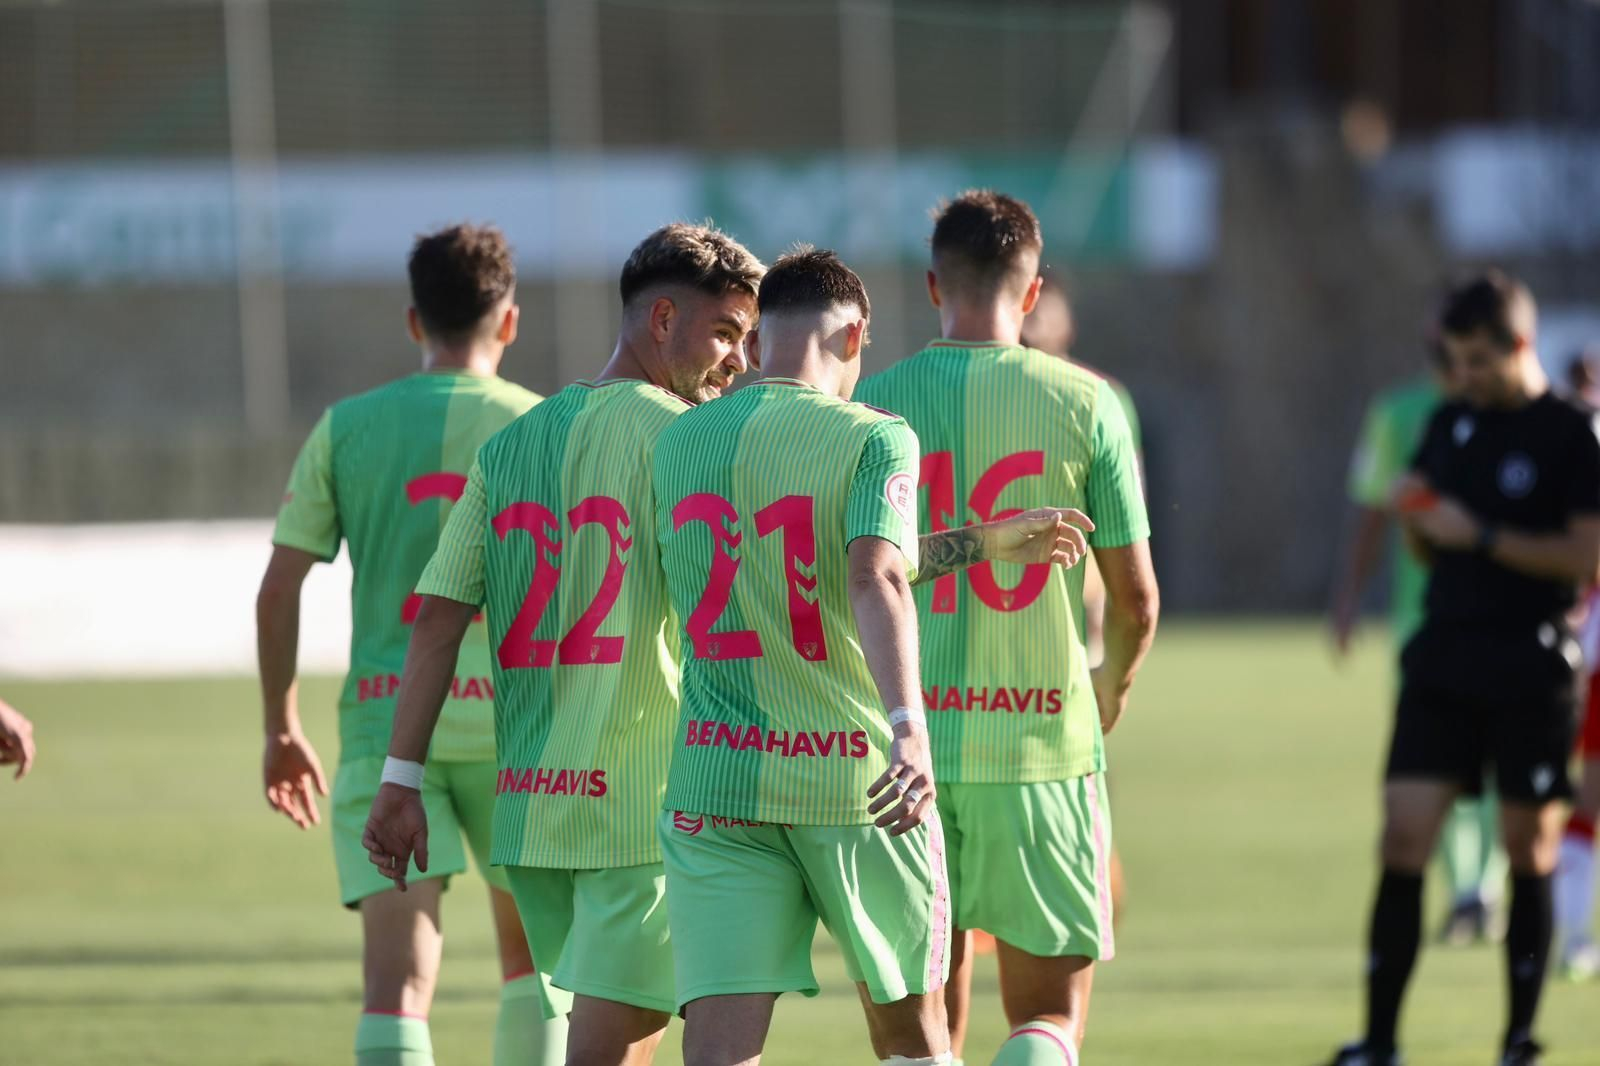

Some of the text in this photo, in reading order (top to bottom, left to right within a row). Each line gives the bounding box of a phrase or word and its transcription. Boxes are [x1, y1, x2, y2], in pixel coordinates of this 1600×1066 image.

[491, 495, 632, 669] 22
[671, 492, 827, 661] 21
[918, 450, 1050, 613] 16
[685, 719, 869, 758] BENAHAVIS
